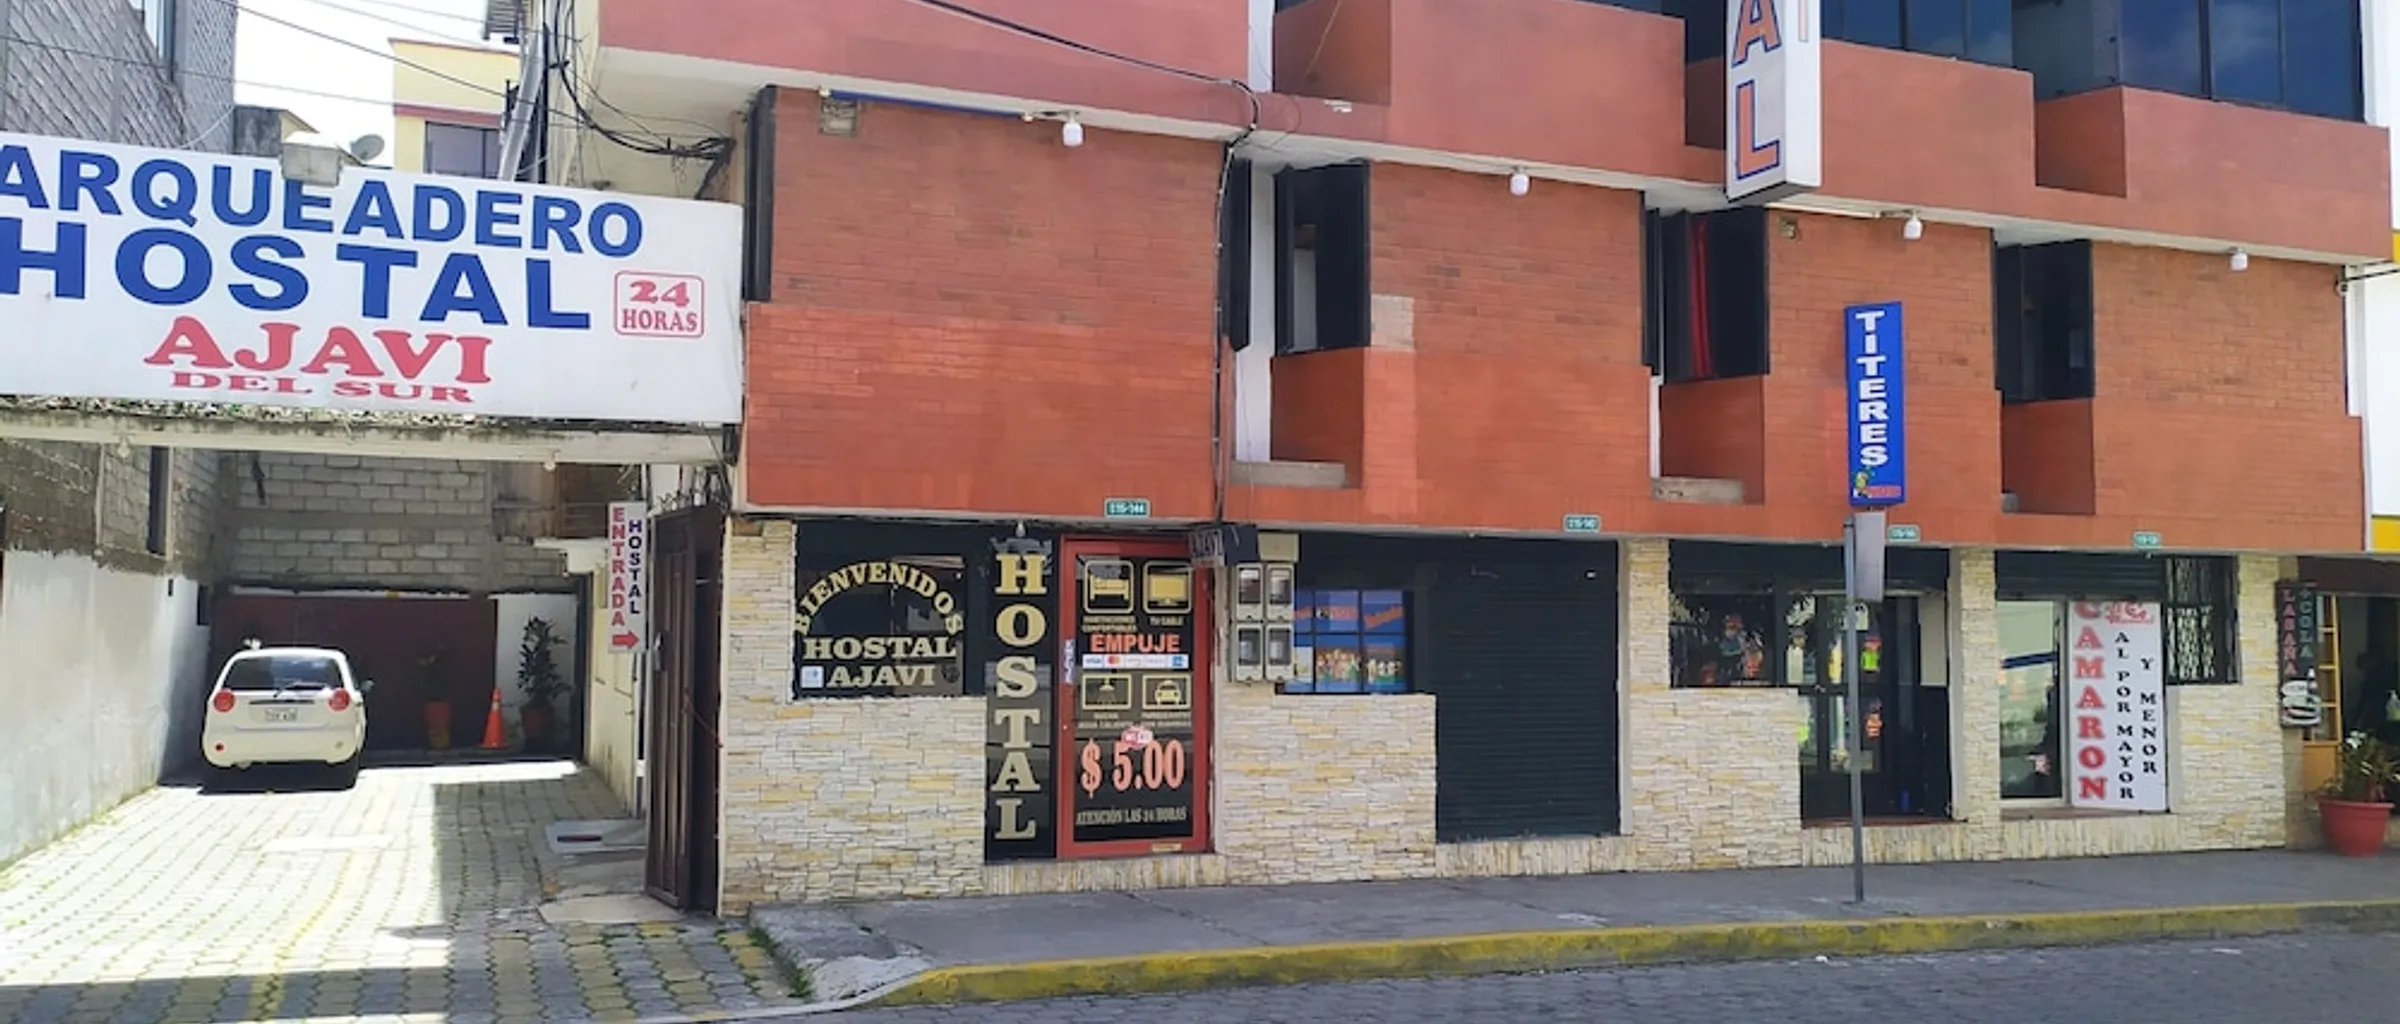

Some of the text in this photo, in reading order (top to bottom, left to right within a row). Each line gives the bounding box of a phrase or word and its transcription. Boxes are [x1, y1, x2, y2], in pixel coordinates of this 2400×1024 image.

[0, 216, 591, 329] HOSTAL
[629, 279, 690, 307] 24
[143, 315, 493, 383] AJAVI
[622, 308, 698, 332] HORAS
[171, 372, 475, 403] DEL SUR
[1855, 310, 1889, 466] TITERES
[612, 507, 625, 626] ENTRADA
[629, 519, 641, 614] HOSTAL
[794, 561, 963, 636] BIENVENIDOS
[804, 636, 957, 660] HOSTAL
[1089, 633, 1180, 652] EMPUJE
[2300, 602, 2313, 658] COLA
[826, 665, 936, 688] AJAVI
[991, 553, 1047, 840] HOSTAL
[2074, 601, 2107, 799] CAMARON
[2115, 631, 2134, 799] AL POR MAYOR
[2140, 658, 2157, 773] Y MENOR
[1080, 738, 1185, 798] $ 5.00
